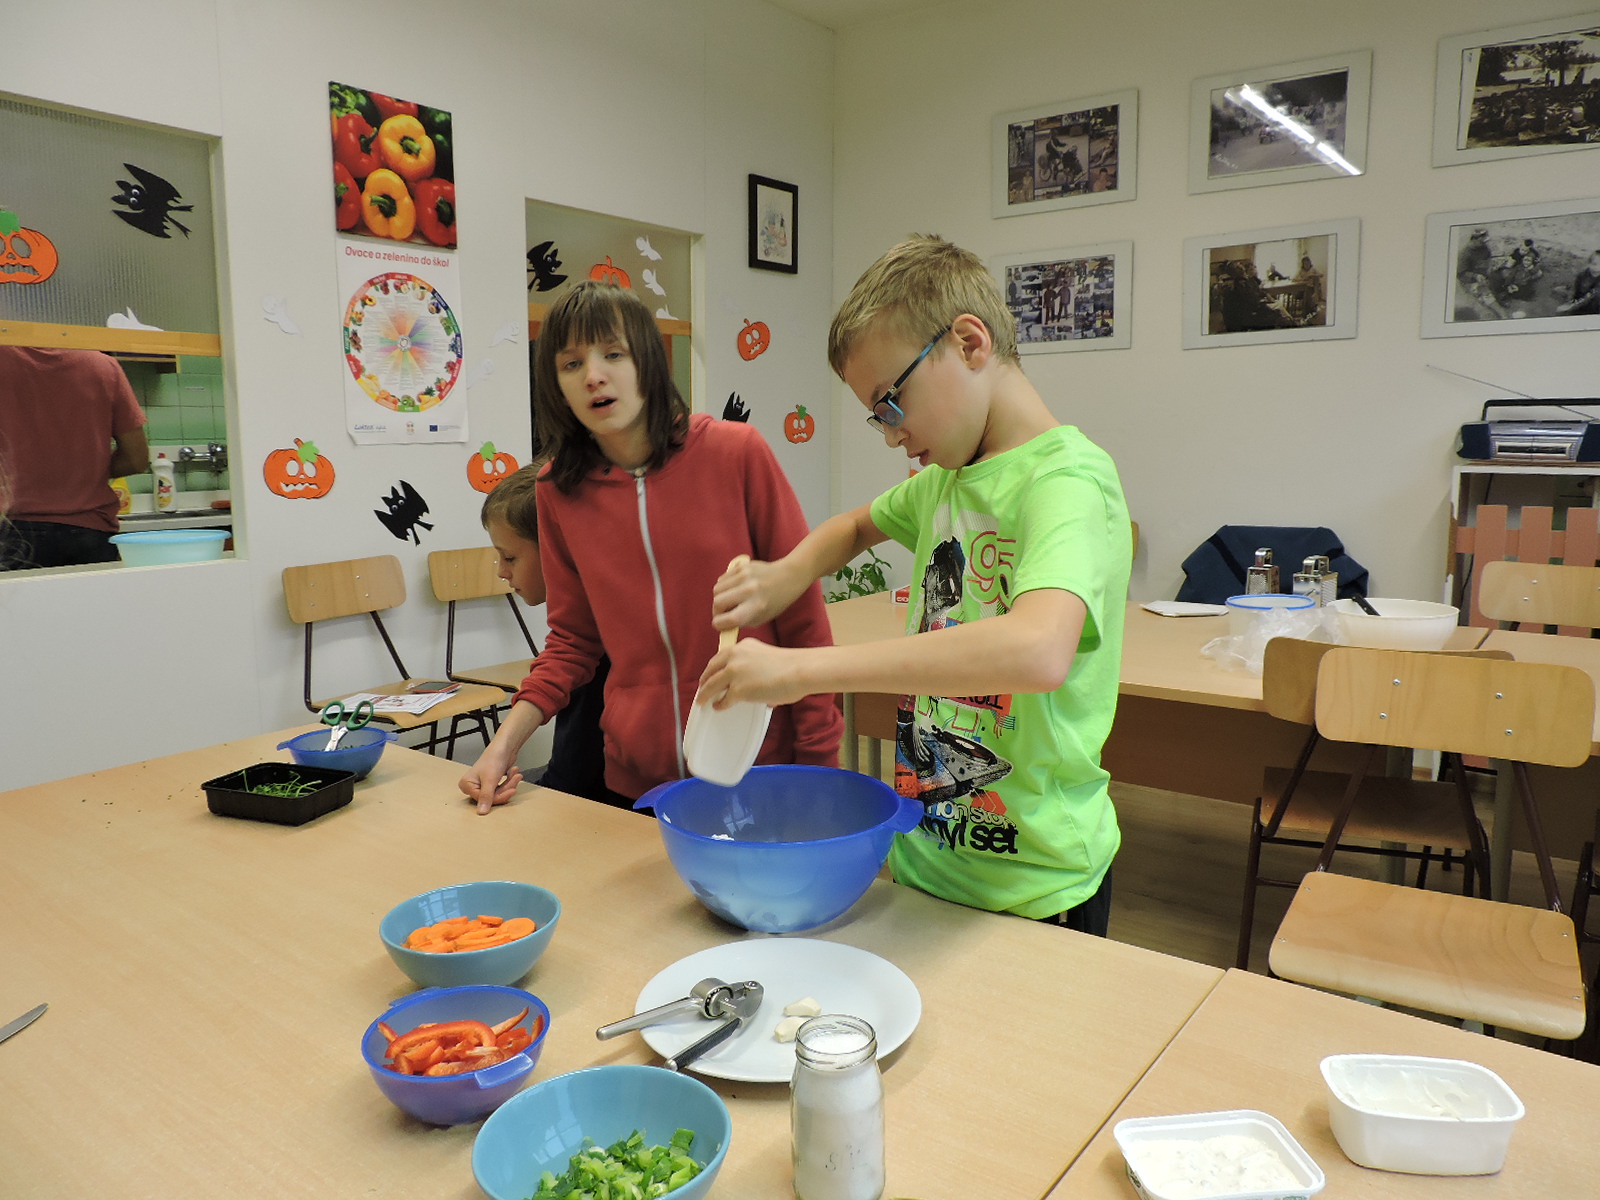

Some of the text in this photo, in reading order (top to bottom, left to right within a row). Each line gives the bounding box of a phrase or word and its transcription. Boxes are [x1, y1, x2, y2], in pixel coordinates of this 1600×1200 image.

[345, 246, 374, 258] Ovoce
[382, 252, 419, 264] zelenina
[420, 256, 432, 266] do
[432, 257, 449, 267] škol
[969, 824, 1018, 854] set
